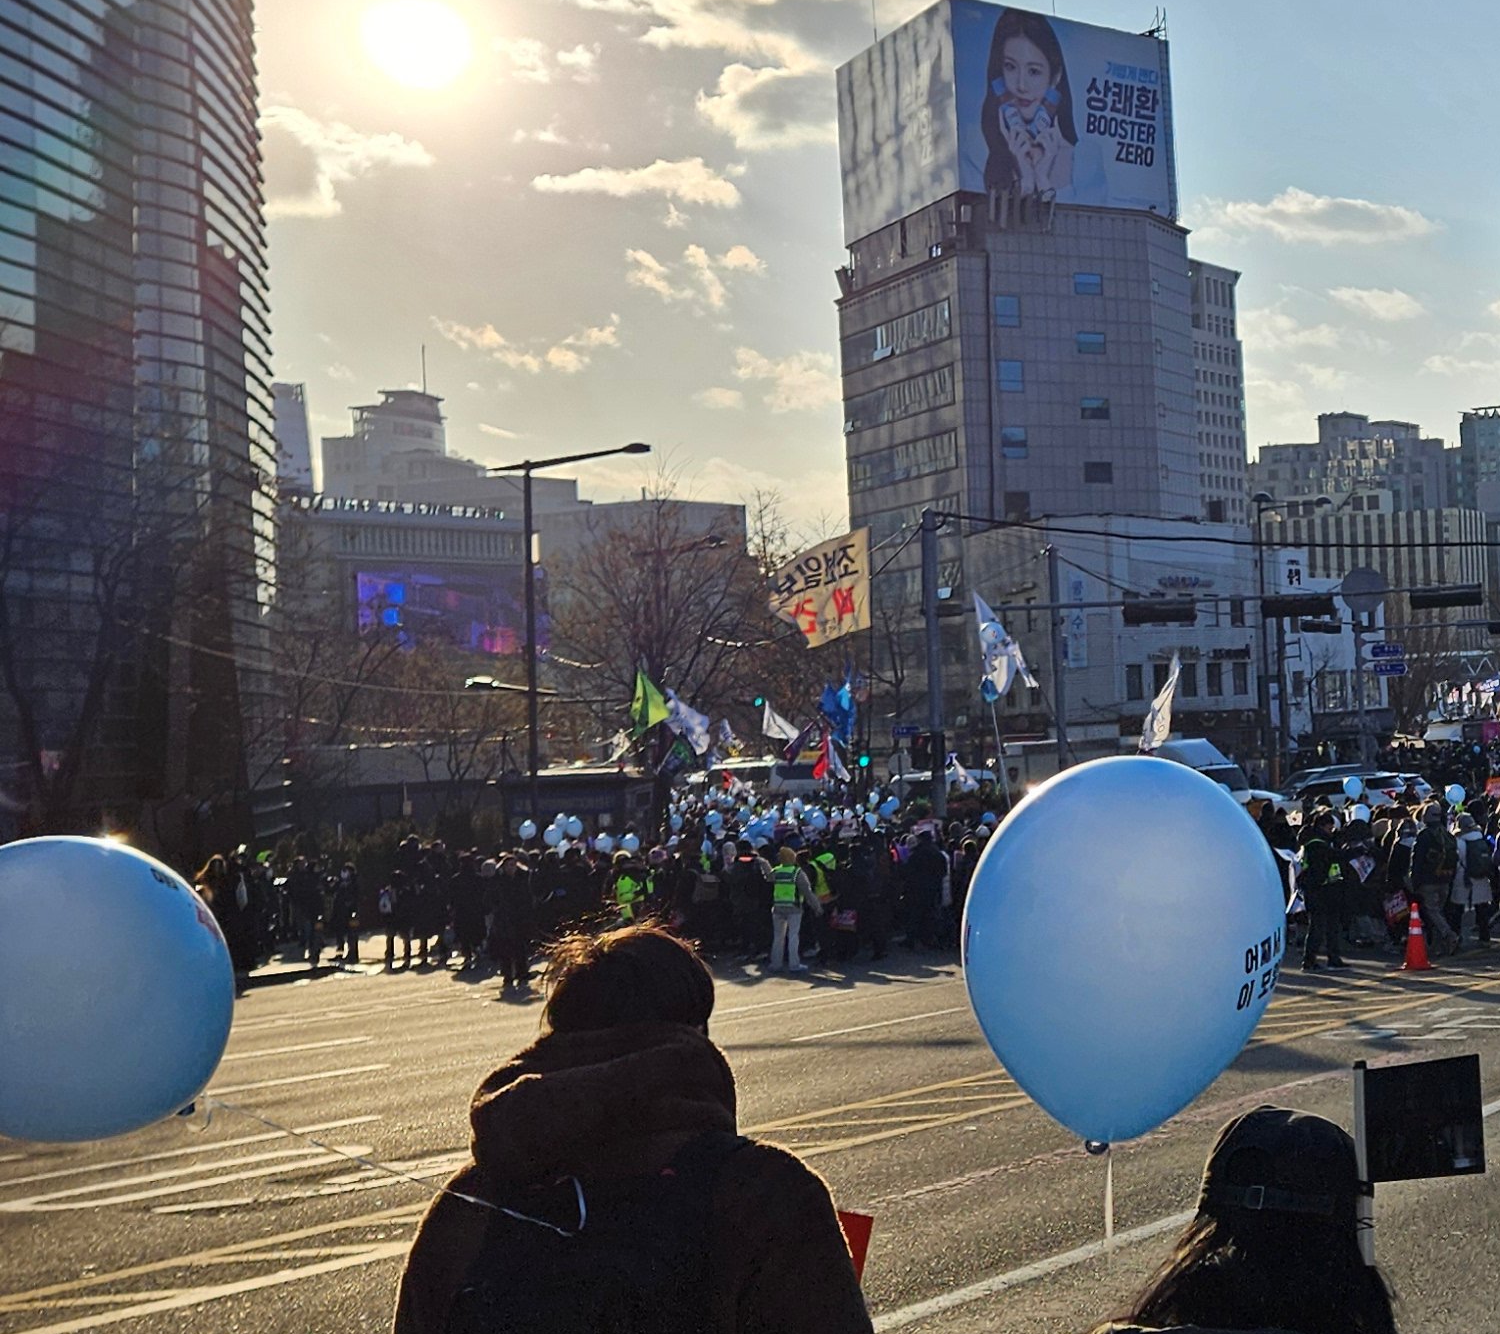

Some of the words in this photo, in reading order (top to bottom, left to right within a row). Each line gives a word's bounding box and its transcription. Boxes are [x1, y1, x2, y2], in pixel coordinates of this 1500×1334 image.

[1086, 77, 1159, 121] 상쾌환
[1086, 112, 1156, 145] BOOSTER
[1115, 141, 1154, 167] ZERO
